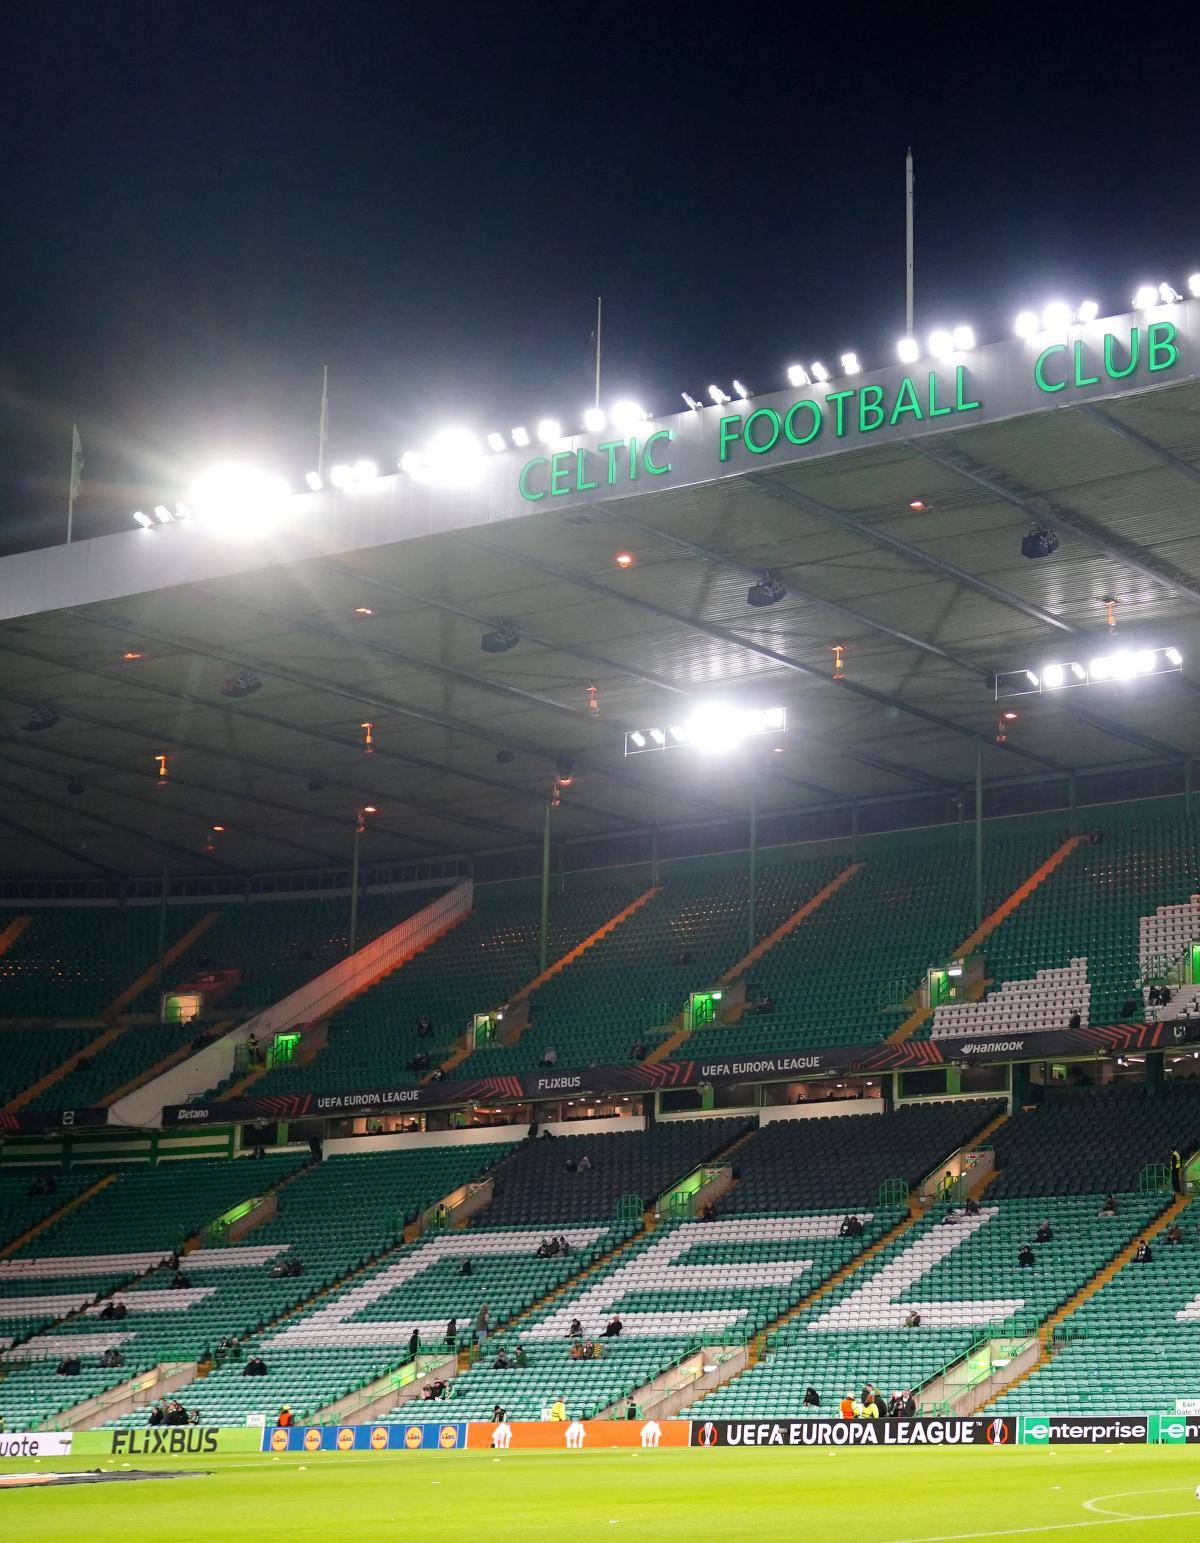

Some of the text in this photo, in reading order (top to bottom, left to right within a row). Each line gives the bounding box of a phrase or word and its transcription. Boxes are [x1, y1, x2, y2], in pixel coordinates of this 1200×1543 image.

[518, 429, 672, 502] CELTIC
[719, 365, 980, 463] FOOTBALL
[1034, 321, 1179, 393] CLUB
[702, 1065, 730, 1076] UEFA
[732, 1061, 775, 1074] EUROPA
[318, 1098, 342, 1108] UEFA
[344, 1094, 380, 1105] EUROPA
[178, 1110, 208, 1119] Betano
[727, 1424, 784, 1445] UEFA
[790, 1422, 879, 1445] EUROPA
[1031, 1421, 1147, 1440] enterprise
